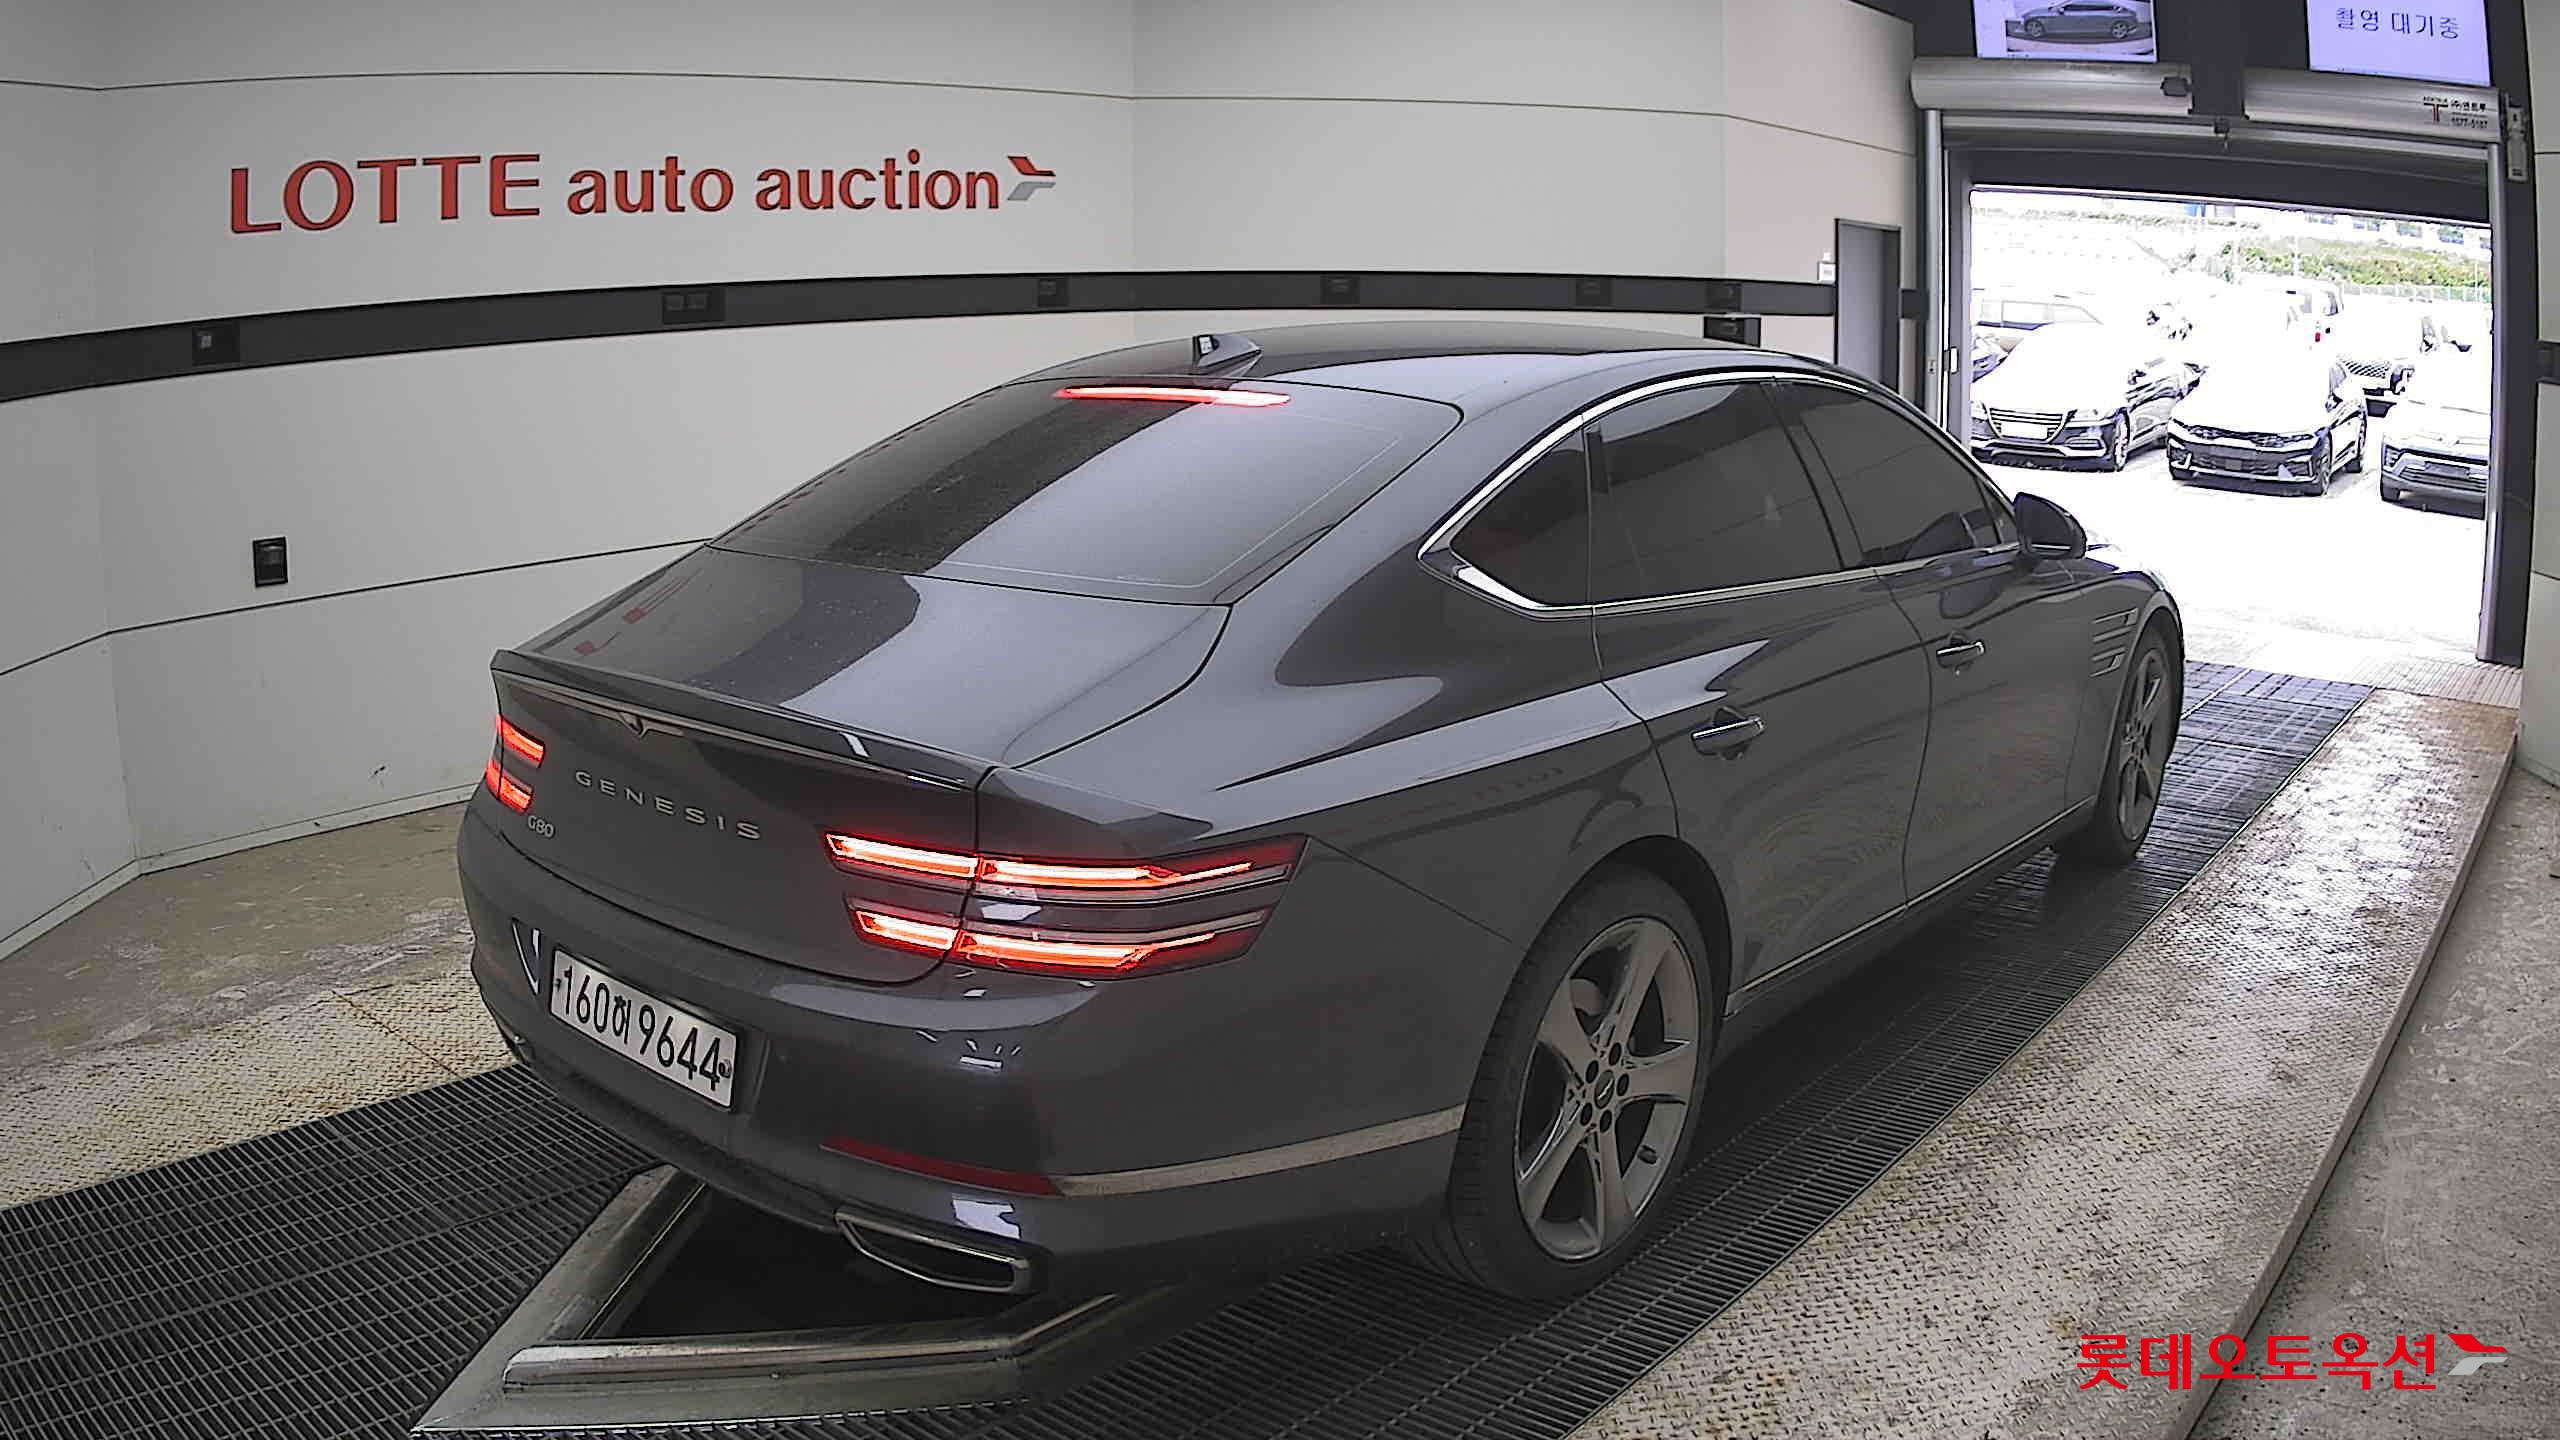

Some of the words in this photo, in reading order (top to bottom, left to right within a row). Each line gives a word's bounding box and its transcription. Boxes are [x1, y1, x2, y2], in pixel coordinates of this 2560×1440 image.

[2336, 8, 2379, 31] 촬영
[2391, 13, 2459, 39] 대기중
[231, 154, 540, 234] LOTTE
[567, 156, 734, 214] auto
[755, 149, 999, 210] auction
[527, 815, 554, 838] G80
[575, 771, 761, 840] GENESIS
[564, 965, 721, 1091] 160허9644
